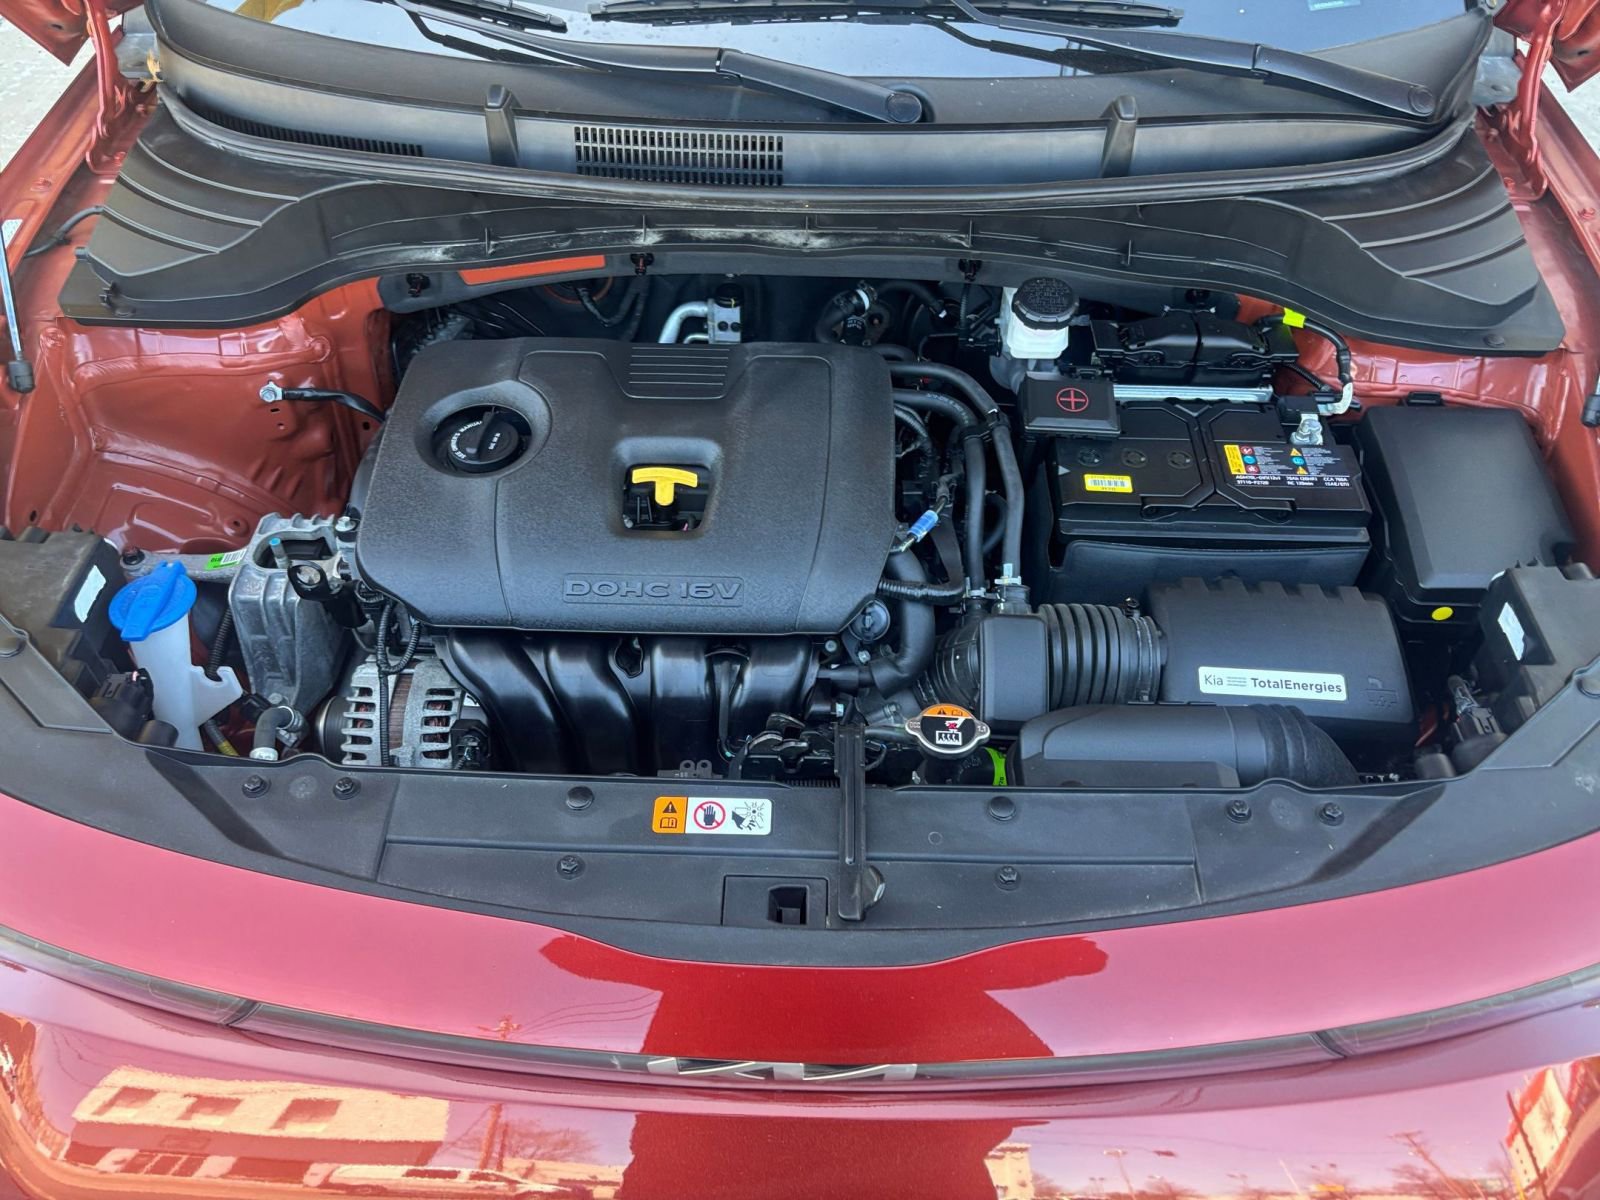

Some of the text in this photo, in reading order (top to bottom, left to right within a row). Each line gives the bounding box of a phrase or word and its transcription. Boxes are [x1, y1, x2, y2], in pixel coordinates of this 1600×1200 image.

[565, 580, 742, 600] DOHC 16V
[1204, 674, 1342, 693] Kia TotalEnergies
